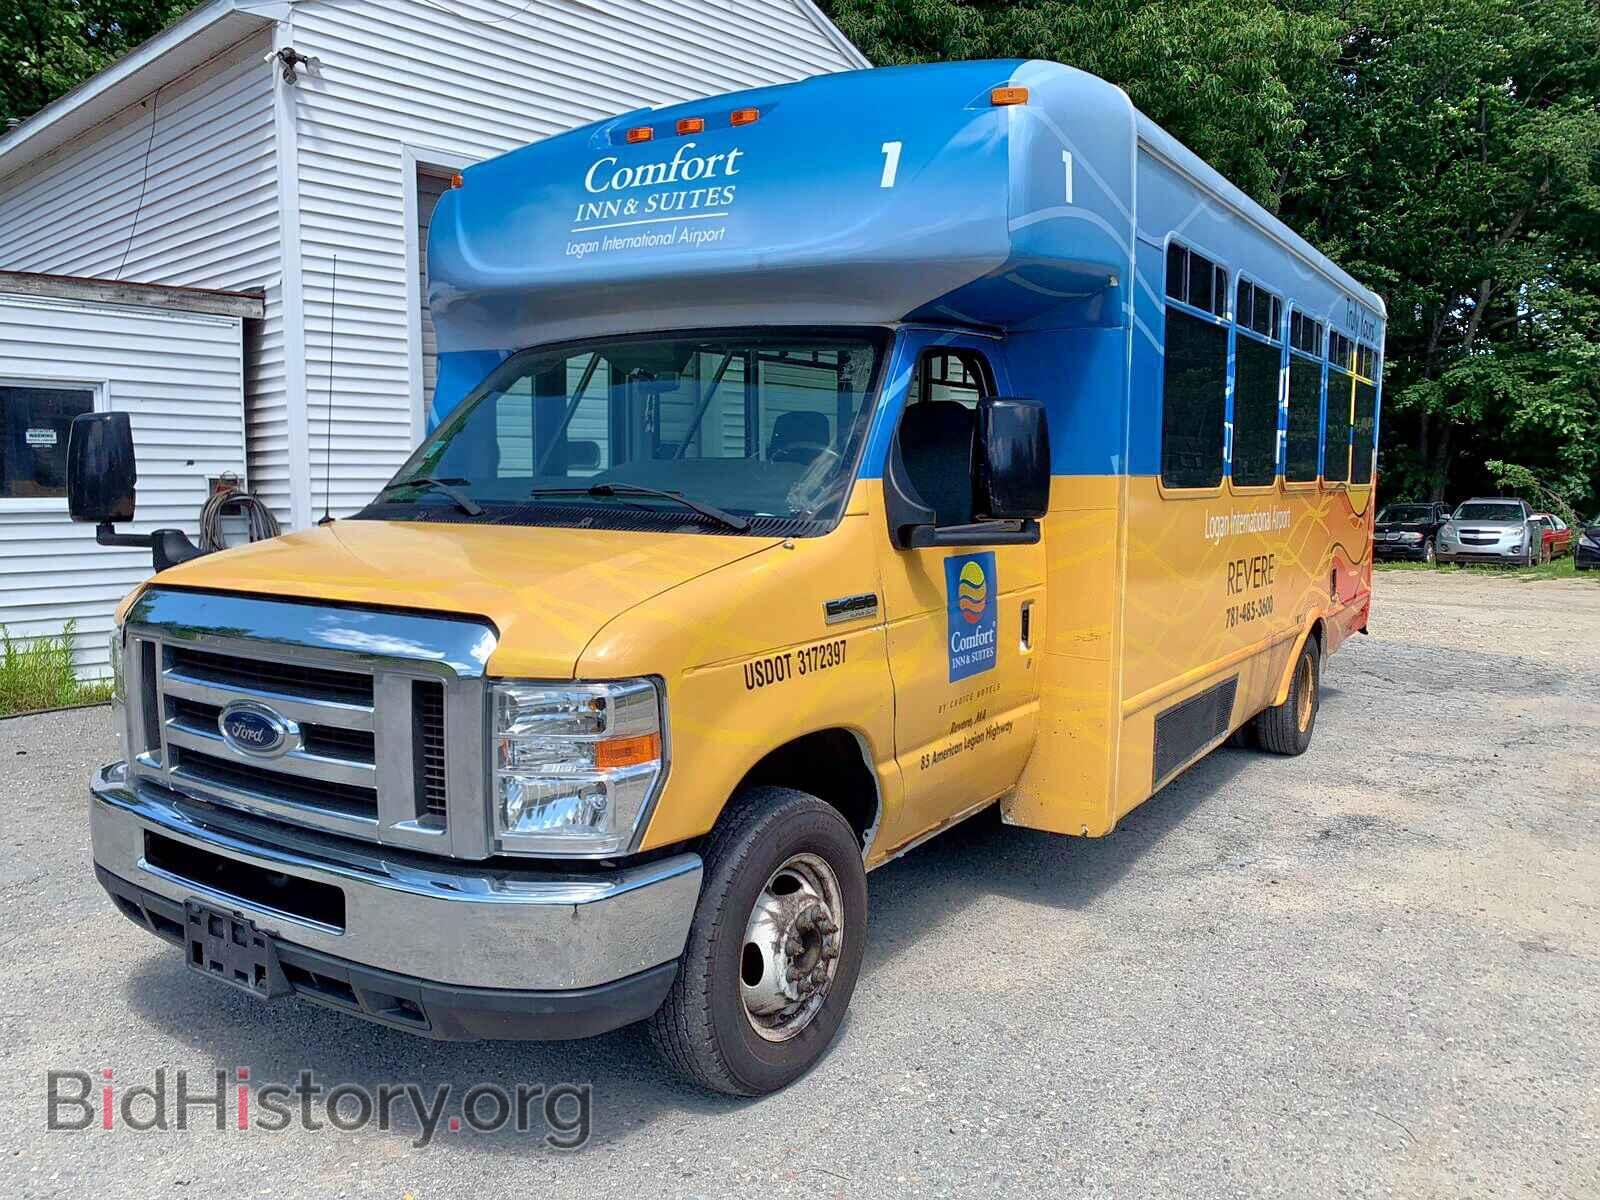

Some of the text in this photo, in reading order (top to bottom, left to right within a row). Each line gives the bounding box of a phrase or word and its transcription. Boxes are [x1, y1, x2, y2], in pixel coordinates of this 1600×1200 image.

[585, 143, 744, 193] Comfort
[880, 141, 903, 189] 1
[1062, 150, 1074, 204] 1
[644, 185, 736, 213] SUITES
[566, 224, 726, 259] Logan International Airport
[1205, 506, 1291, 545] Logan International Airport
[1227, 554, 1275, 596] REVERE
[1225, 595, 1274, 629] 781-485-3600
[951, 625, 994, 653] Comfort
[971, 647, 994, 663] SUITES
[744, 640, 847, 690] USDOT 3172397
[232, 722, 264, 744] Ford
[932, 742, 963, 766] American
[963, 731, 985, 751] Legion
[985, 720, 1013, 741] Highway
